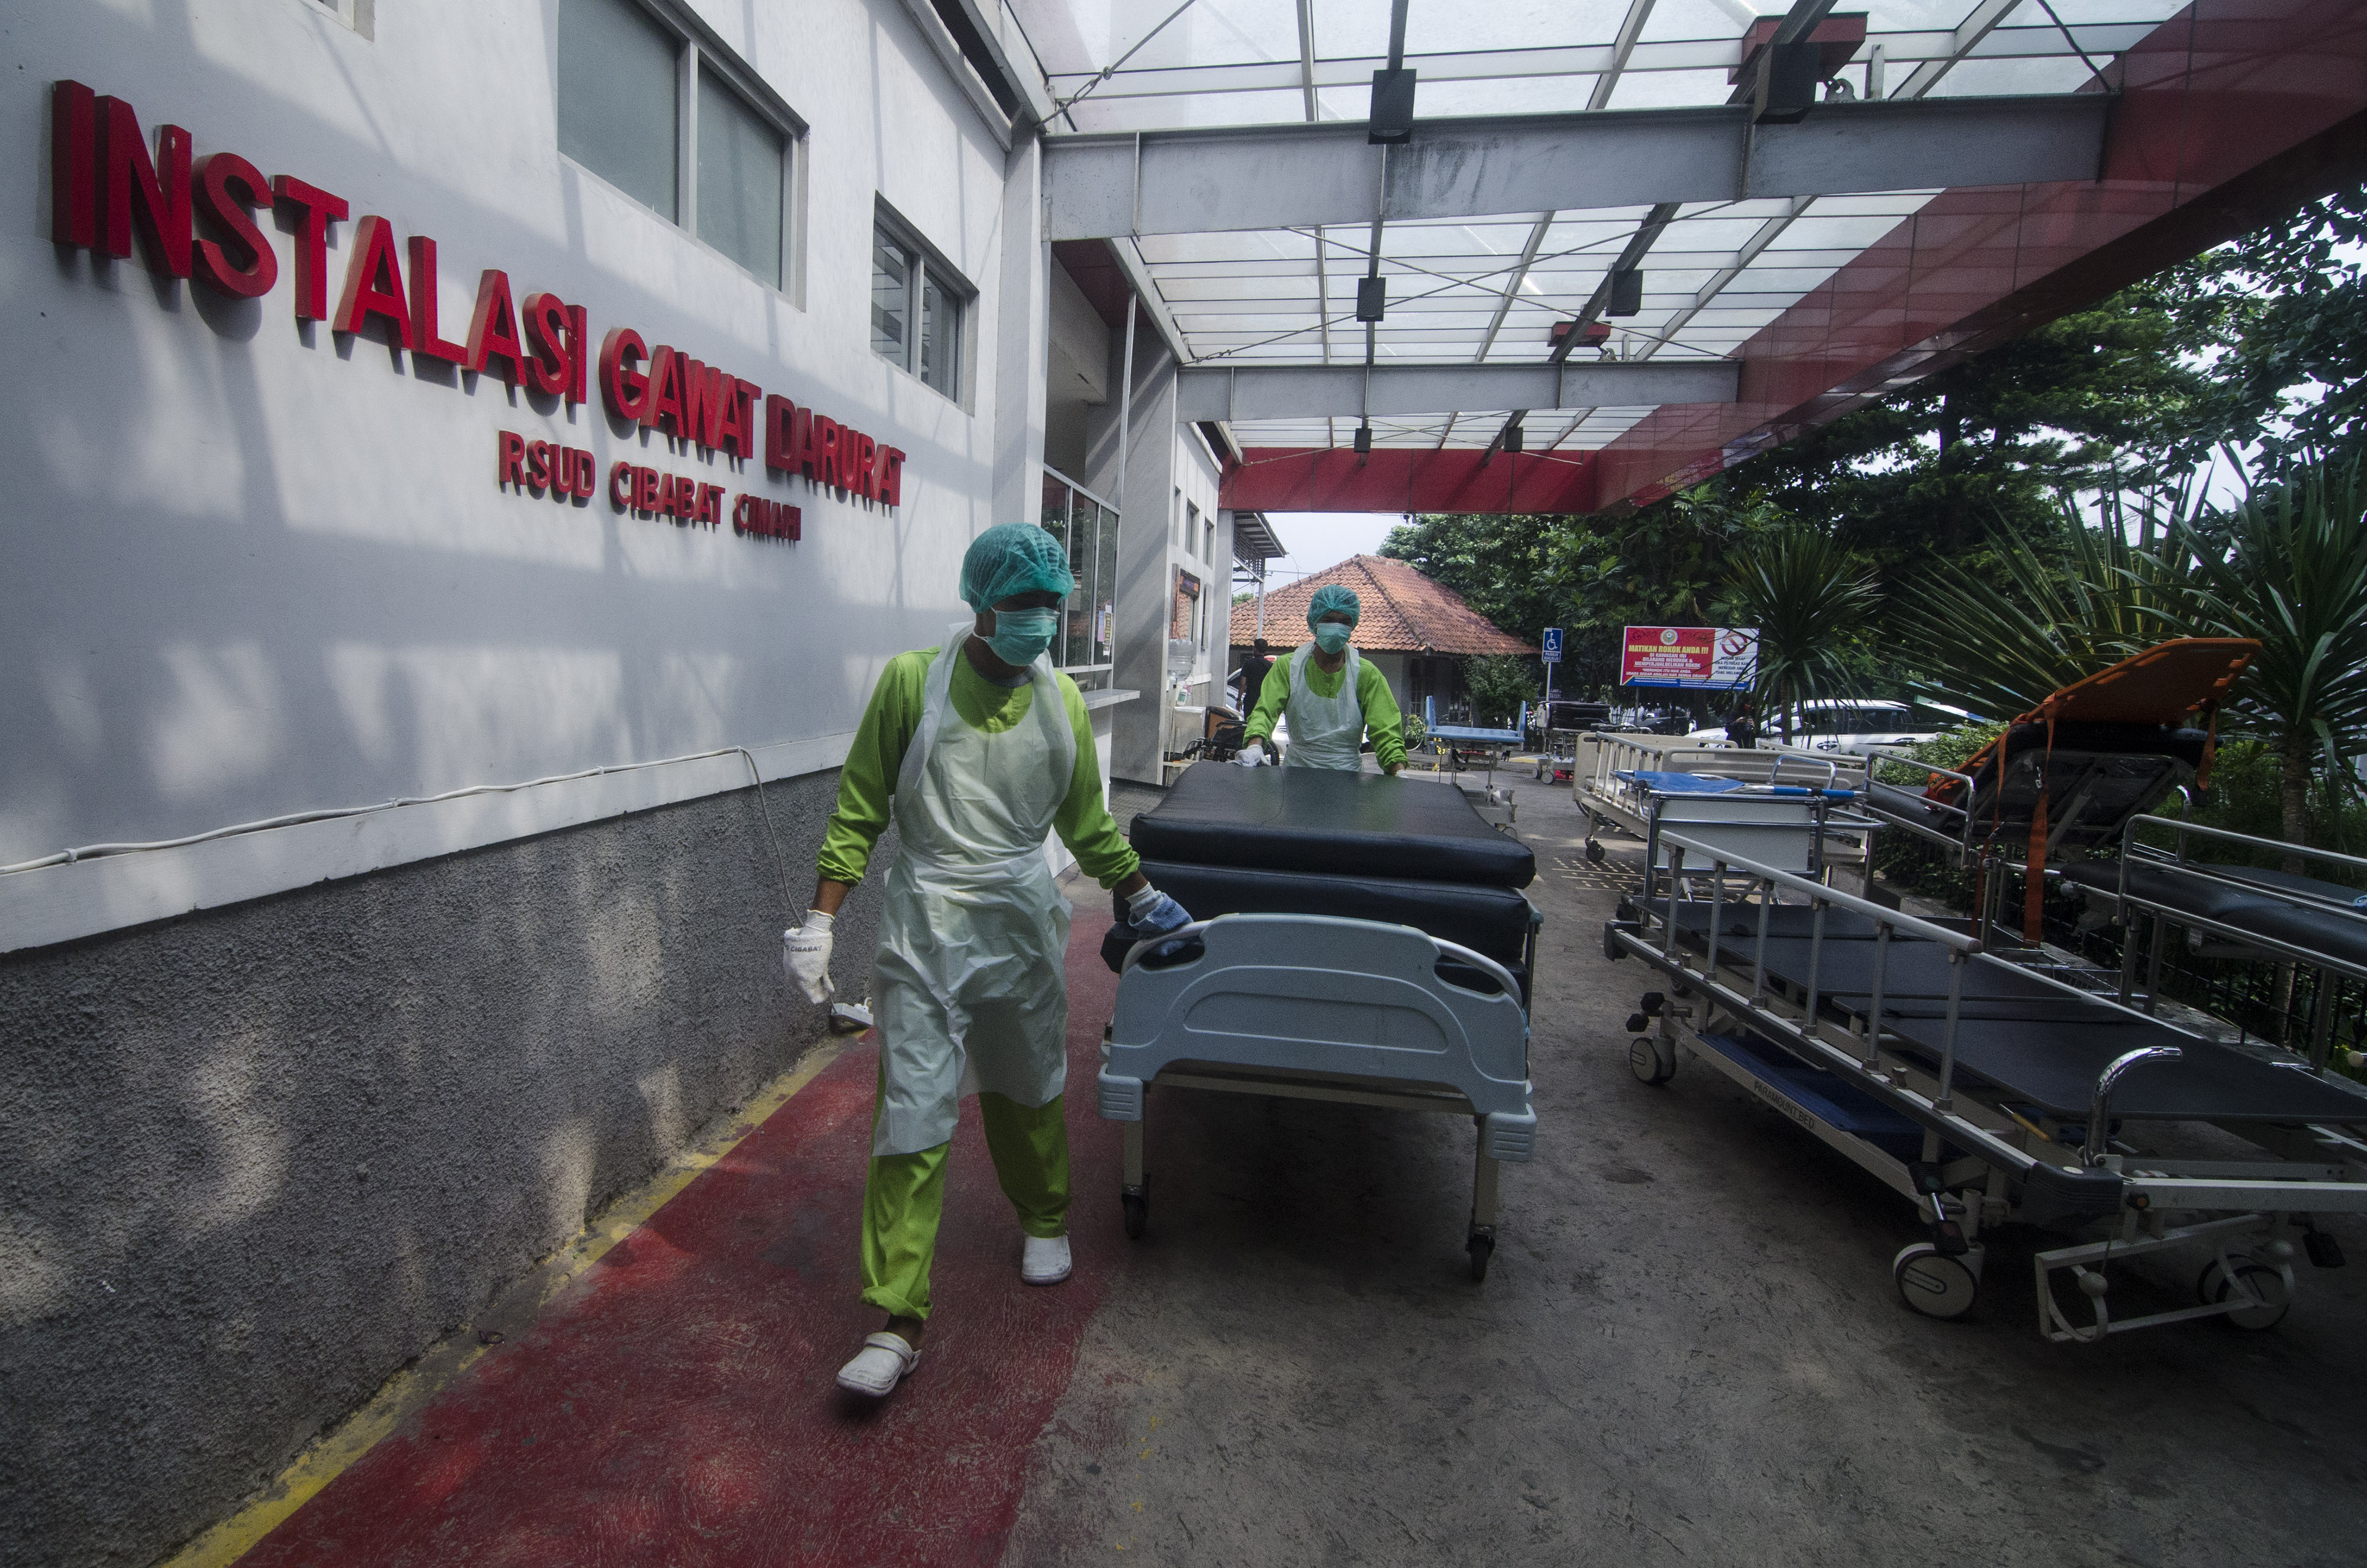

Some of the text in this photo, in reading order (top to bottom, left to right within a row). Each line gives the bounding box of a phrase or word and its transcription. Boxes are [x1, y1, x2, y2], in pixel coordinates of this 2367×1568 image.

[52, 79, 906, 506] INSTALASI GAWAT DARURAT
[499, 430, 801, 541] RSUD CIBABAT CIMAHI
[1755, 1081, 1814, 1128] PARAMOUNT BED
